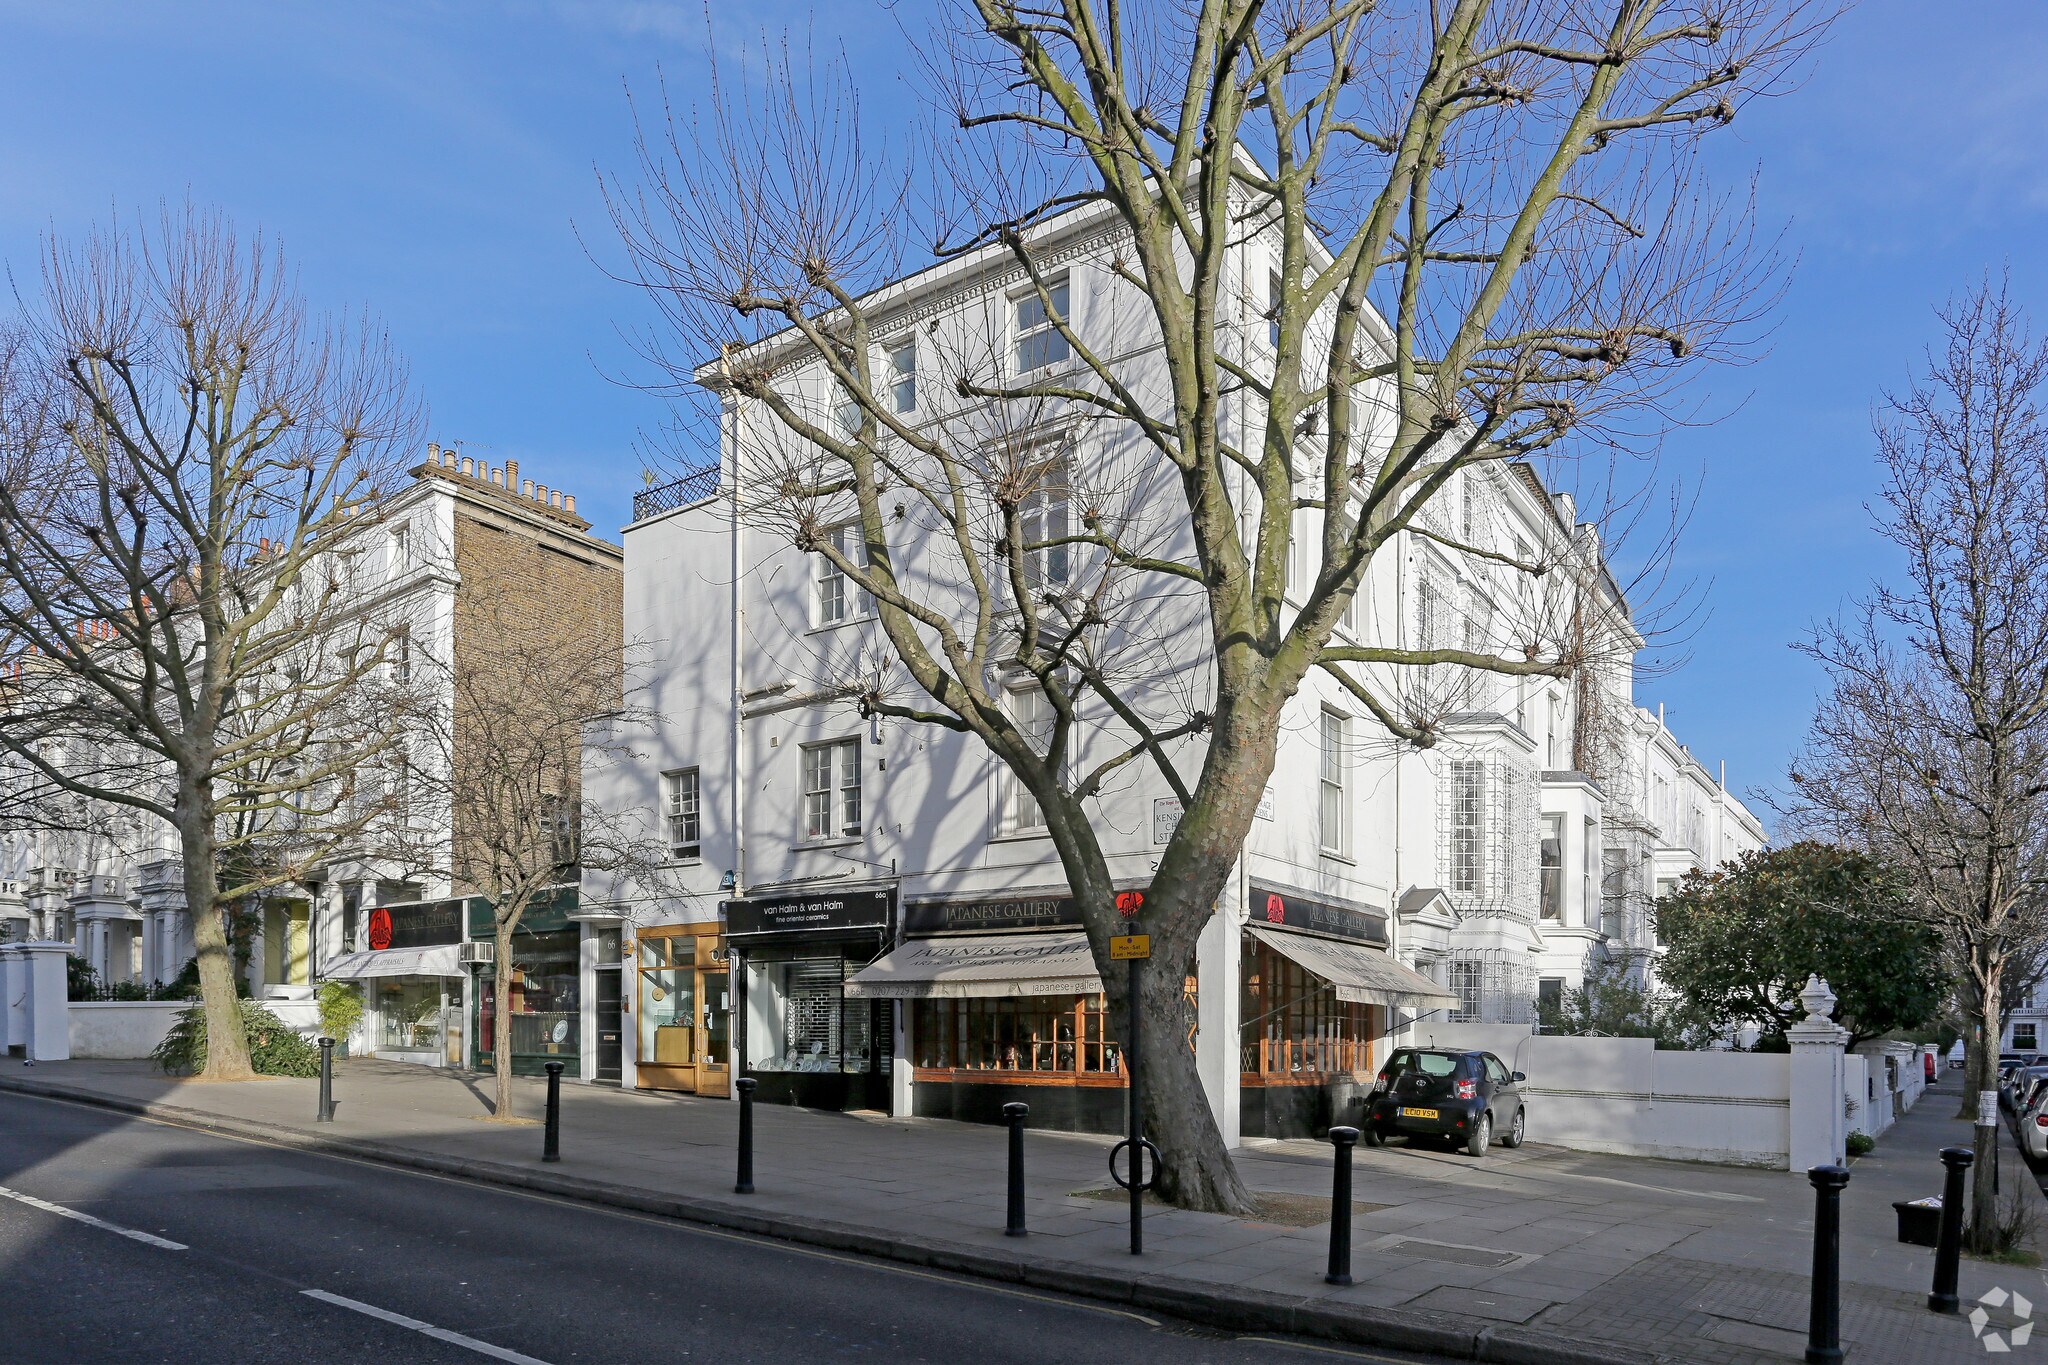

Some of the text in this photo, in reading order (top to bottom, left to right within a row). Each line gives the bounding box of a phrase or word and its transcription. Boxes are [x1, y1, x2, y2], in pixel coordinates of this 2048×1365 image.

[763, 900, 844, 915] van Halm & van Halm
[946, 903, 1000, 923] JAPANESE
[1003, 900, 1060, 918] GALLERY
[425, 910, 459, 926] GALLERY
[786, 914, 805, 923] oriental
[805, 913, 830, 922] ceramics
[1309, 906, 1340, 925] JAPANESE
[1340, 912, 1367, 930] GALLERY
[607, 938, 616, 950] 66
[907, 944, 1091, 960] JAPANESE GALLE
